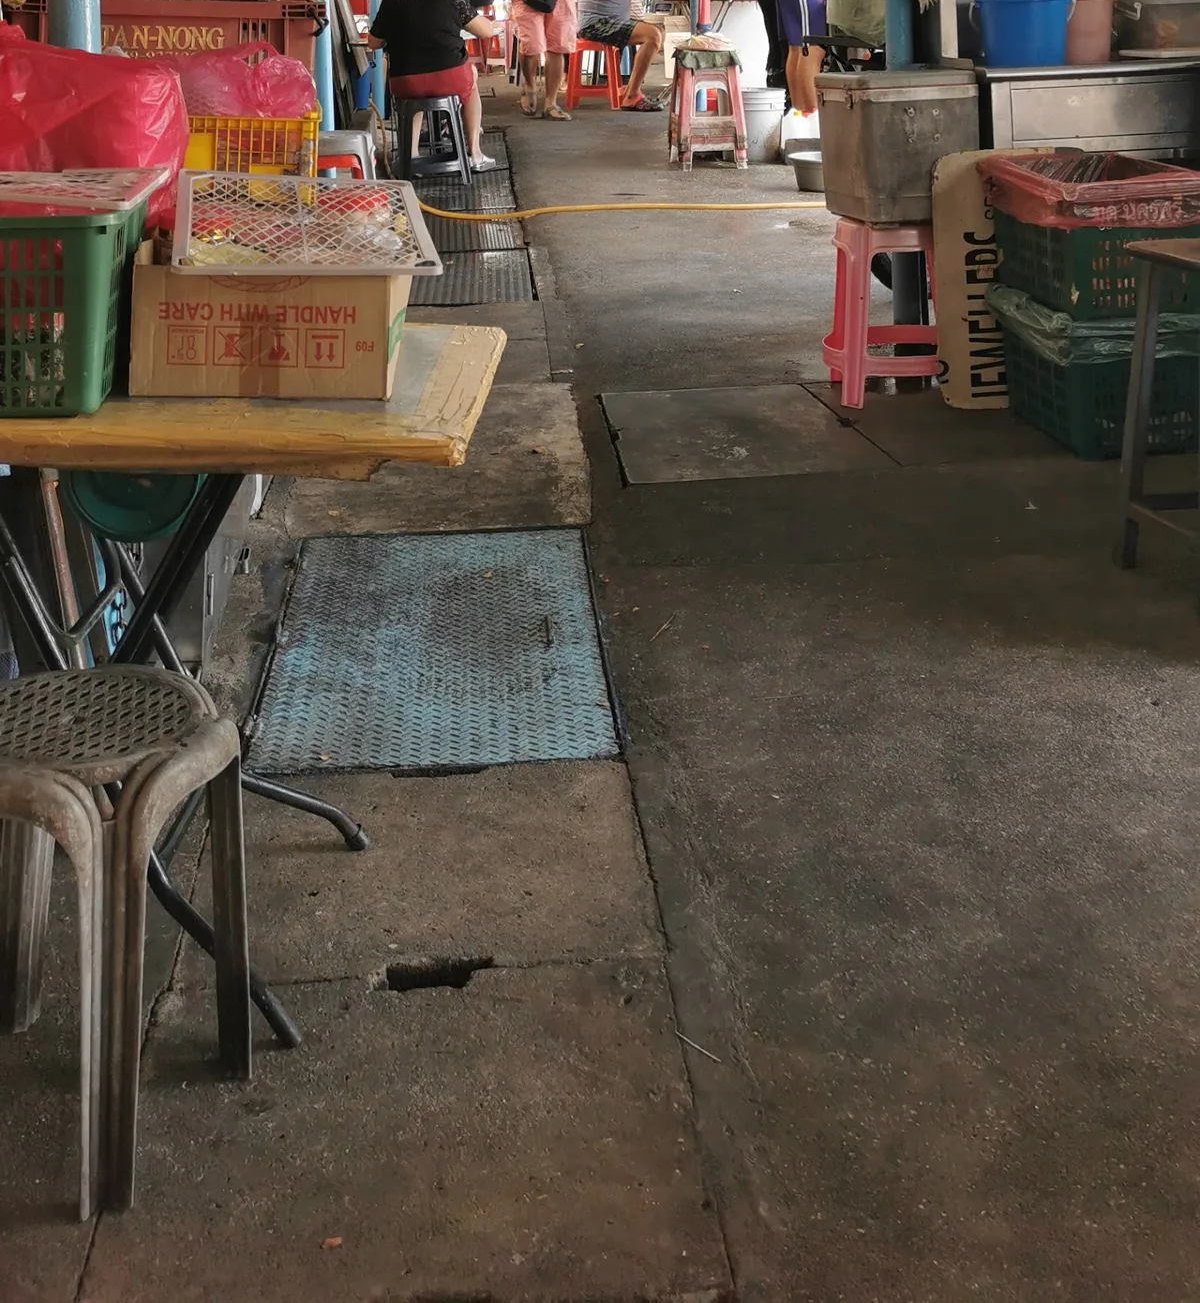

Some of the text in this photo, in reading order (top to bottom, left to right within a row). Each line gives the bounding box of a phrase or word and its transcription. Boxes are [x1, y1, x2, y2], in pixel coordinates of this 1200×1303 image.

[158, 301, 357, 325] HANDLE WITH CARE
[355, 340, 375, 353] F09
